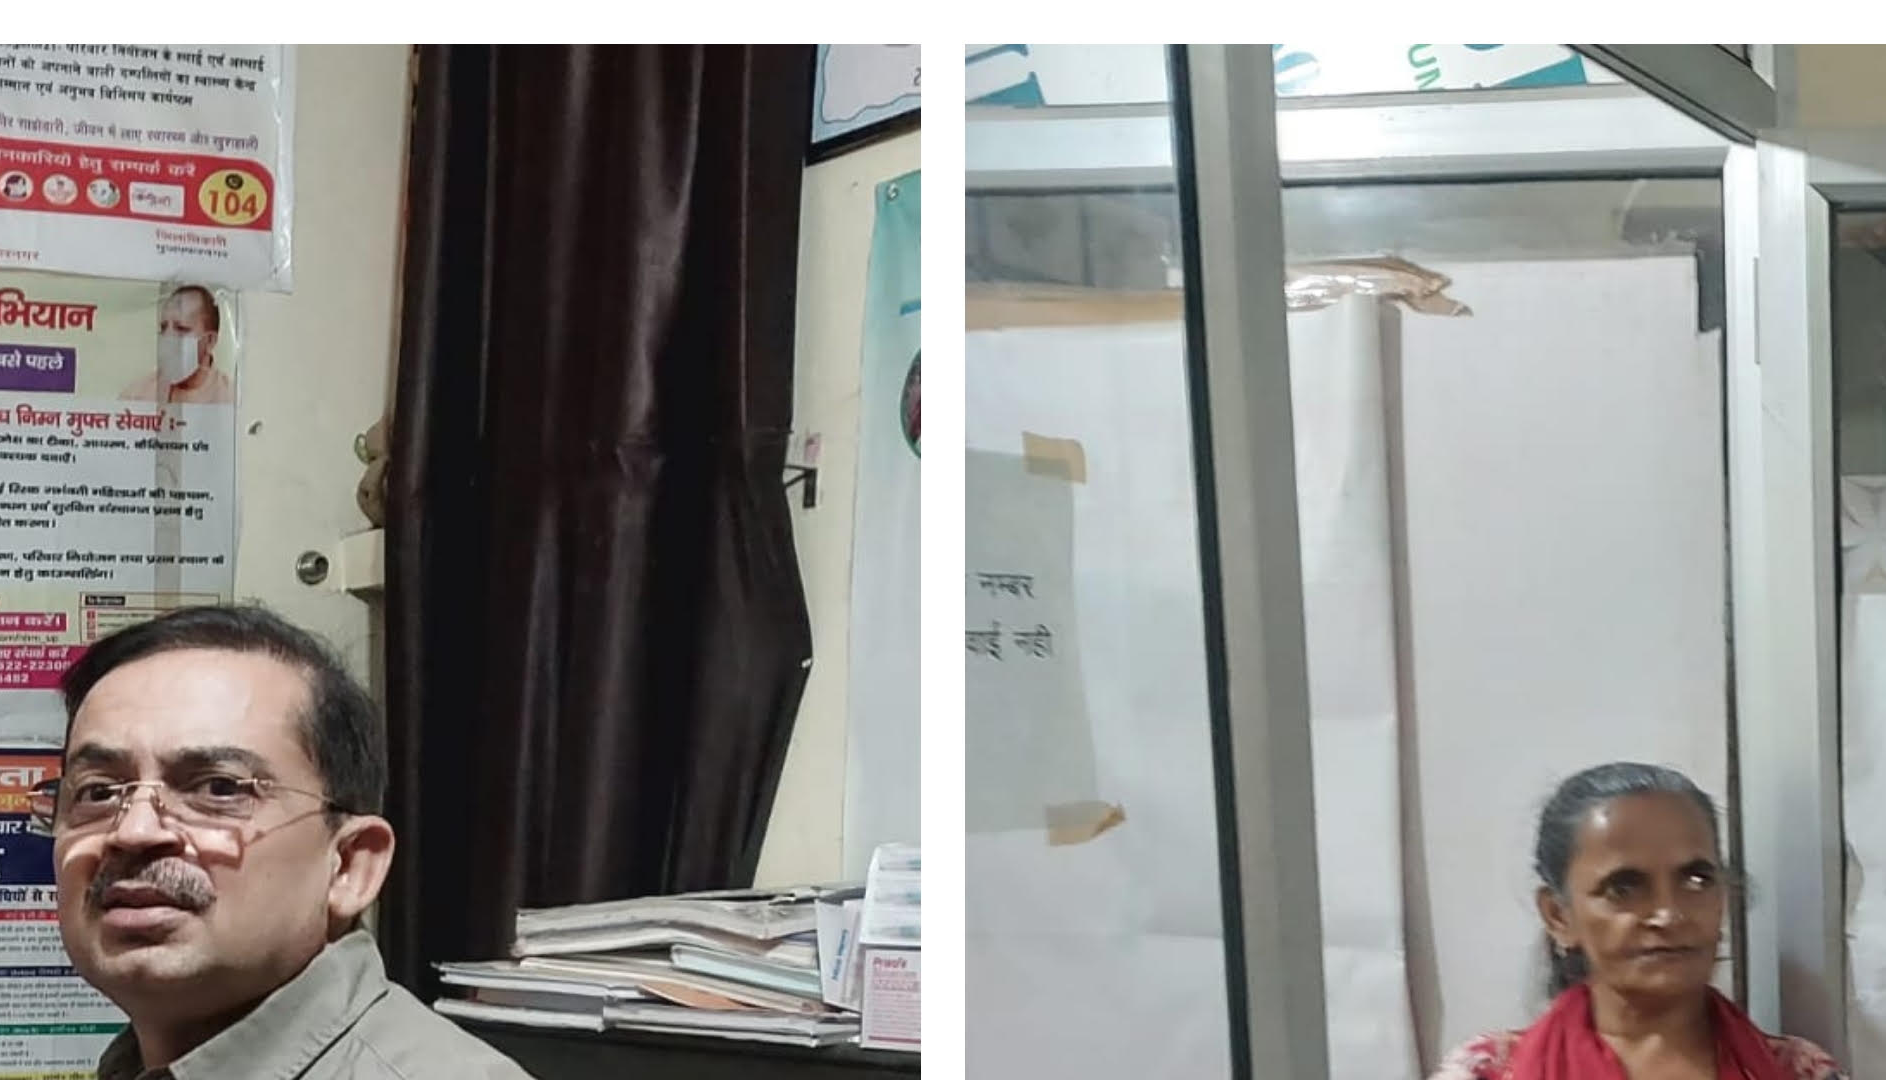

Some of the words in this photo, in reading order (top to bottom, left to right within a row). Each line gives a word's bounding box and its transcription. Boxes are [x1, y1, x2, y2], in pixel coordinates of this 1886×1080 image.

[208, 190, 259, 218] 104
[26, 351, 64, 371] पहले
[16, 403, 61, 428] निम्न
[65, 410, 110, 436] मुफ्त
